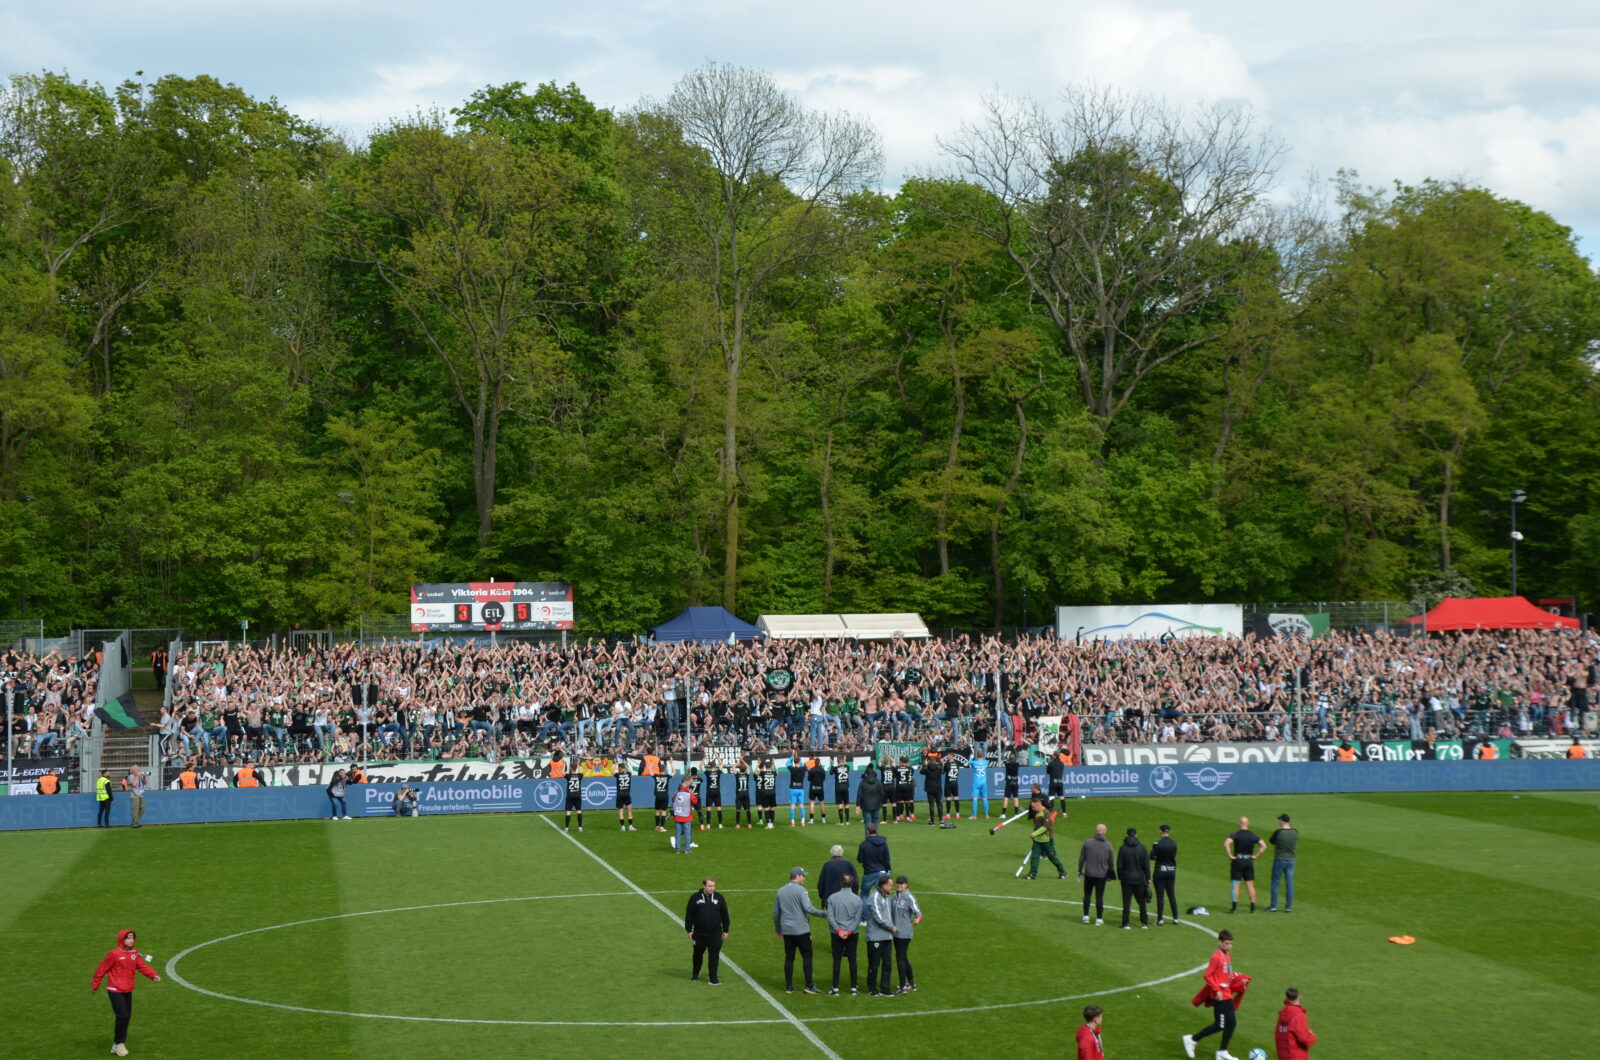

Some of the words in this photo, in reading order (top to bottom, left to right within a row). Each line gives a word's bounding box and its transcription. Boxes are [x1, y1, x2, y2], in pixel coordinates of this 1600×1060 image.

[451, 588, 488, 597] Viktoria
[490, 588, 511, 596] Köln
[512, 588, 534, 596] 1904
[458, 604, 468, 621] 3
[517, 603, 528, 620] 5
[838, 771, 849, 780] 25
[948, 768, 959, 779] 42
[1063, 769, 1140, 784] utomobile
[619, 778, 630, 787] 32
[764, 777, 775, 787] 28
[425, 784, 524, 801] Automobile
[588, 790, 606, 798] MINI
